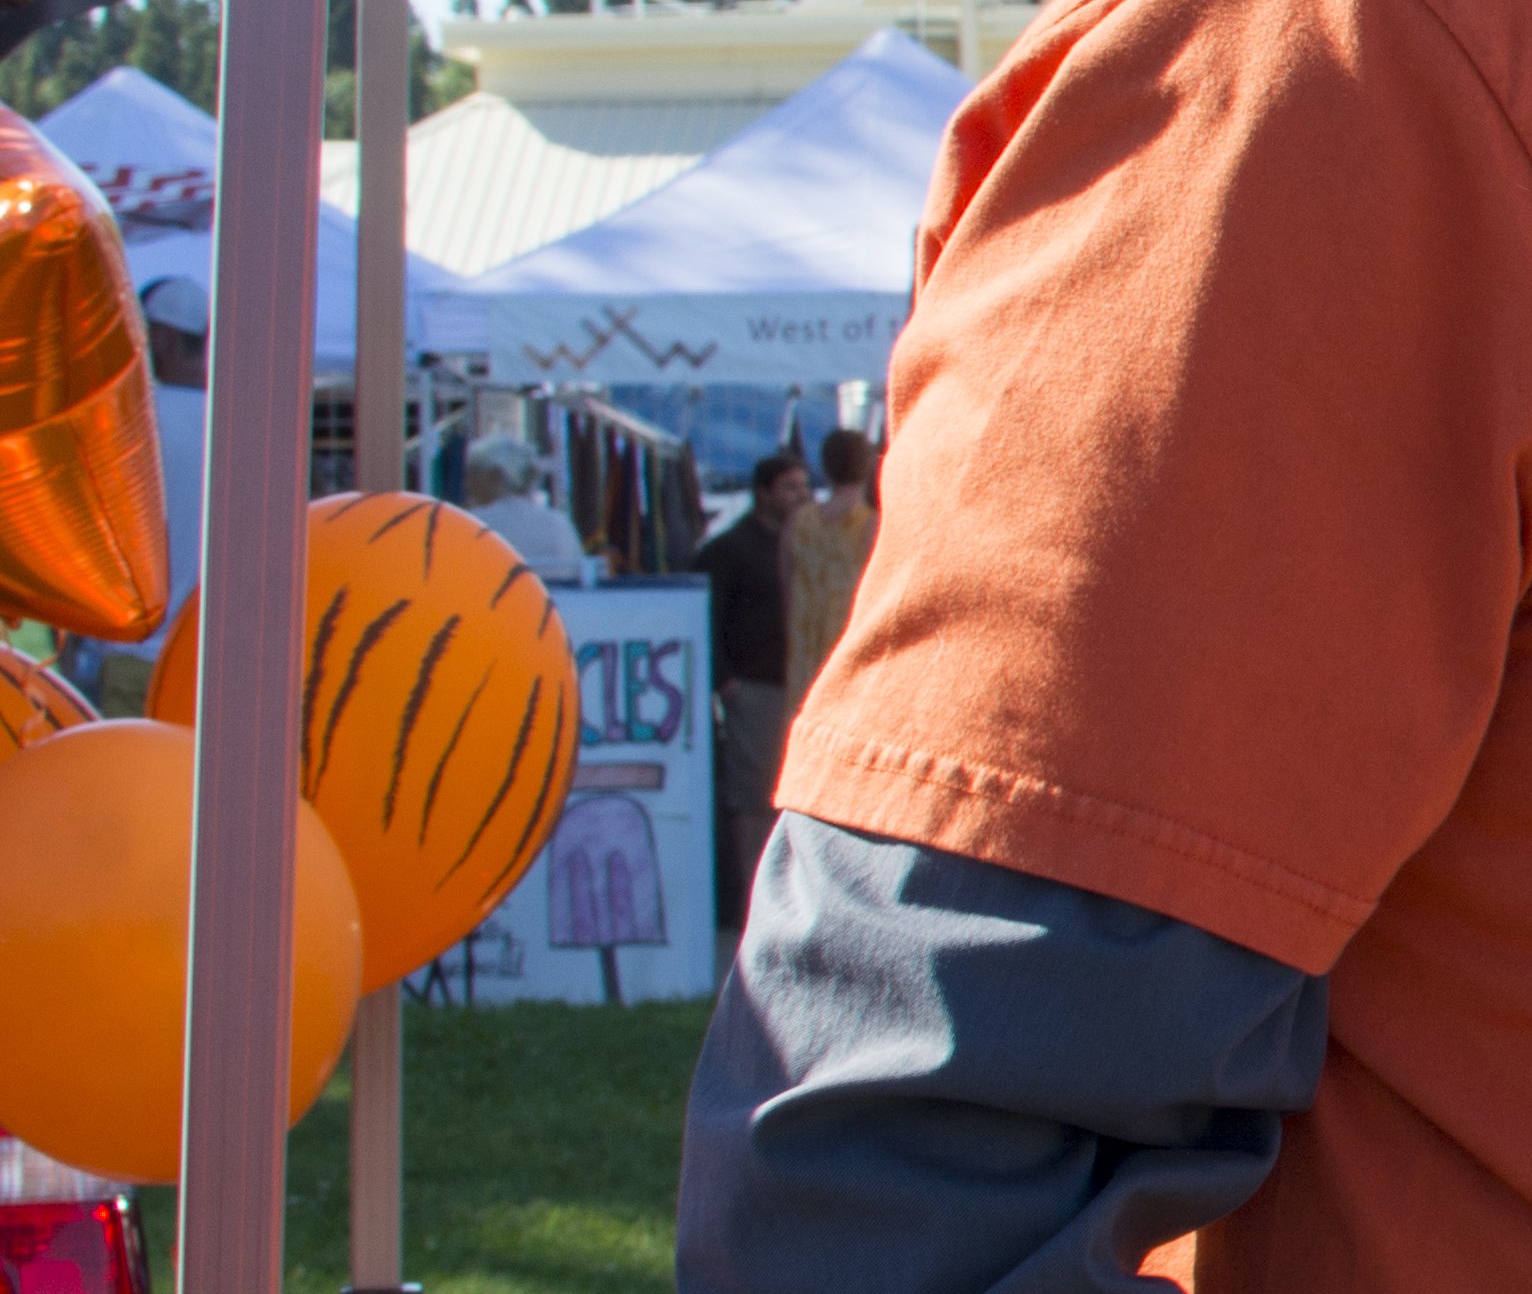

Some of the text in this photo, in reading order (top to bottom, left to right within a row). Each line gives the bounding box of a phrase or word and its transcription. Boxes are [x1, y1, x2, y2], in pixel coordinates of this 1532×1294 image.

[745, 317, 829, 344] West
[842, 315, 876, 343] of
[576, 637, 693, 752] CLES!
